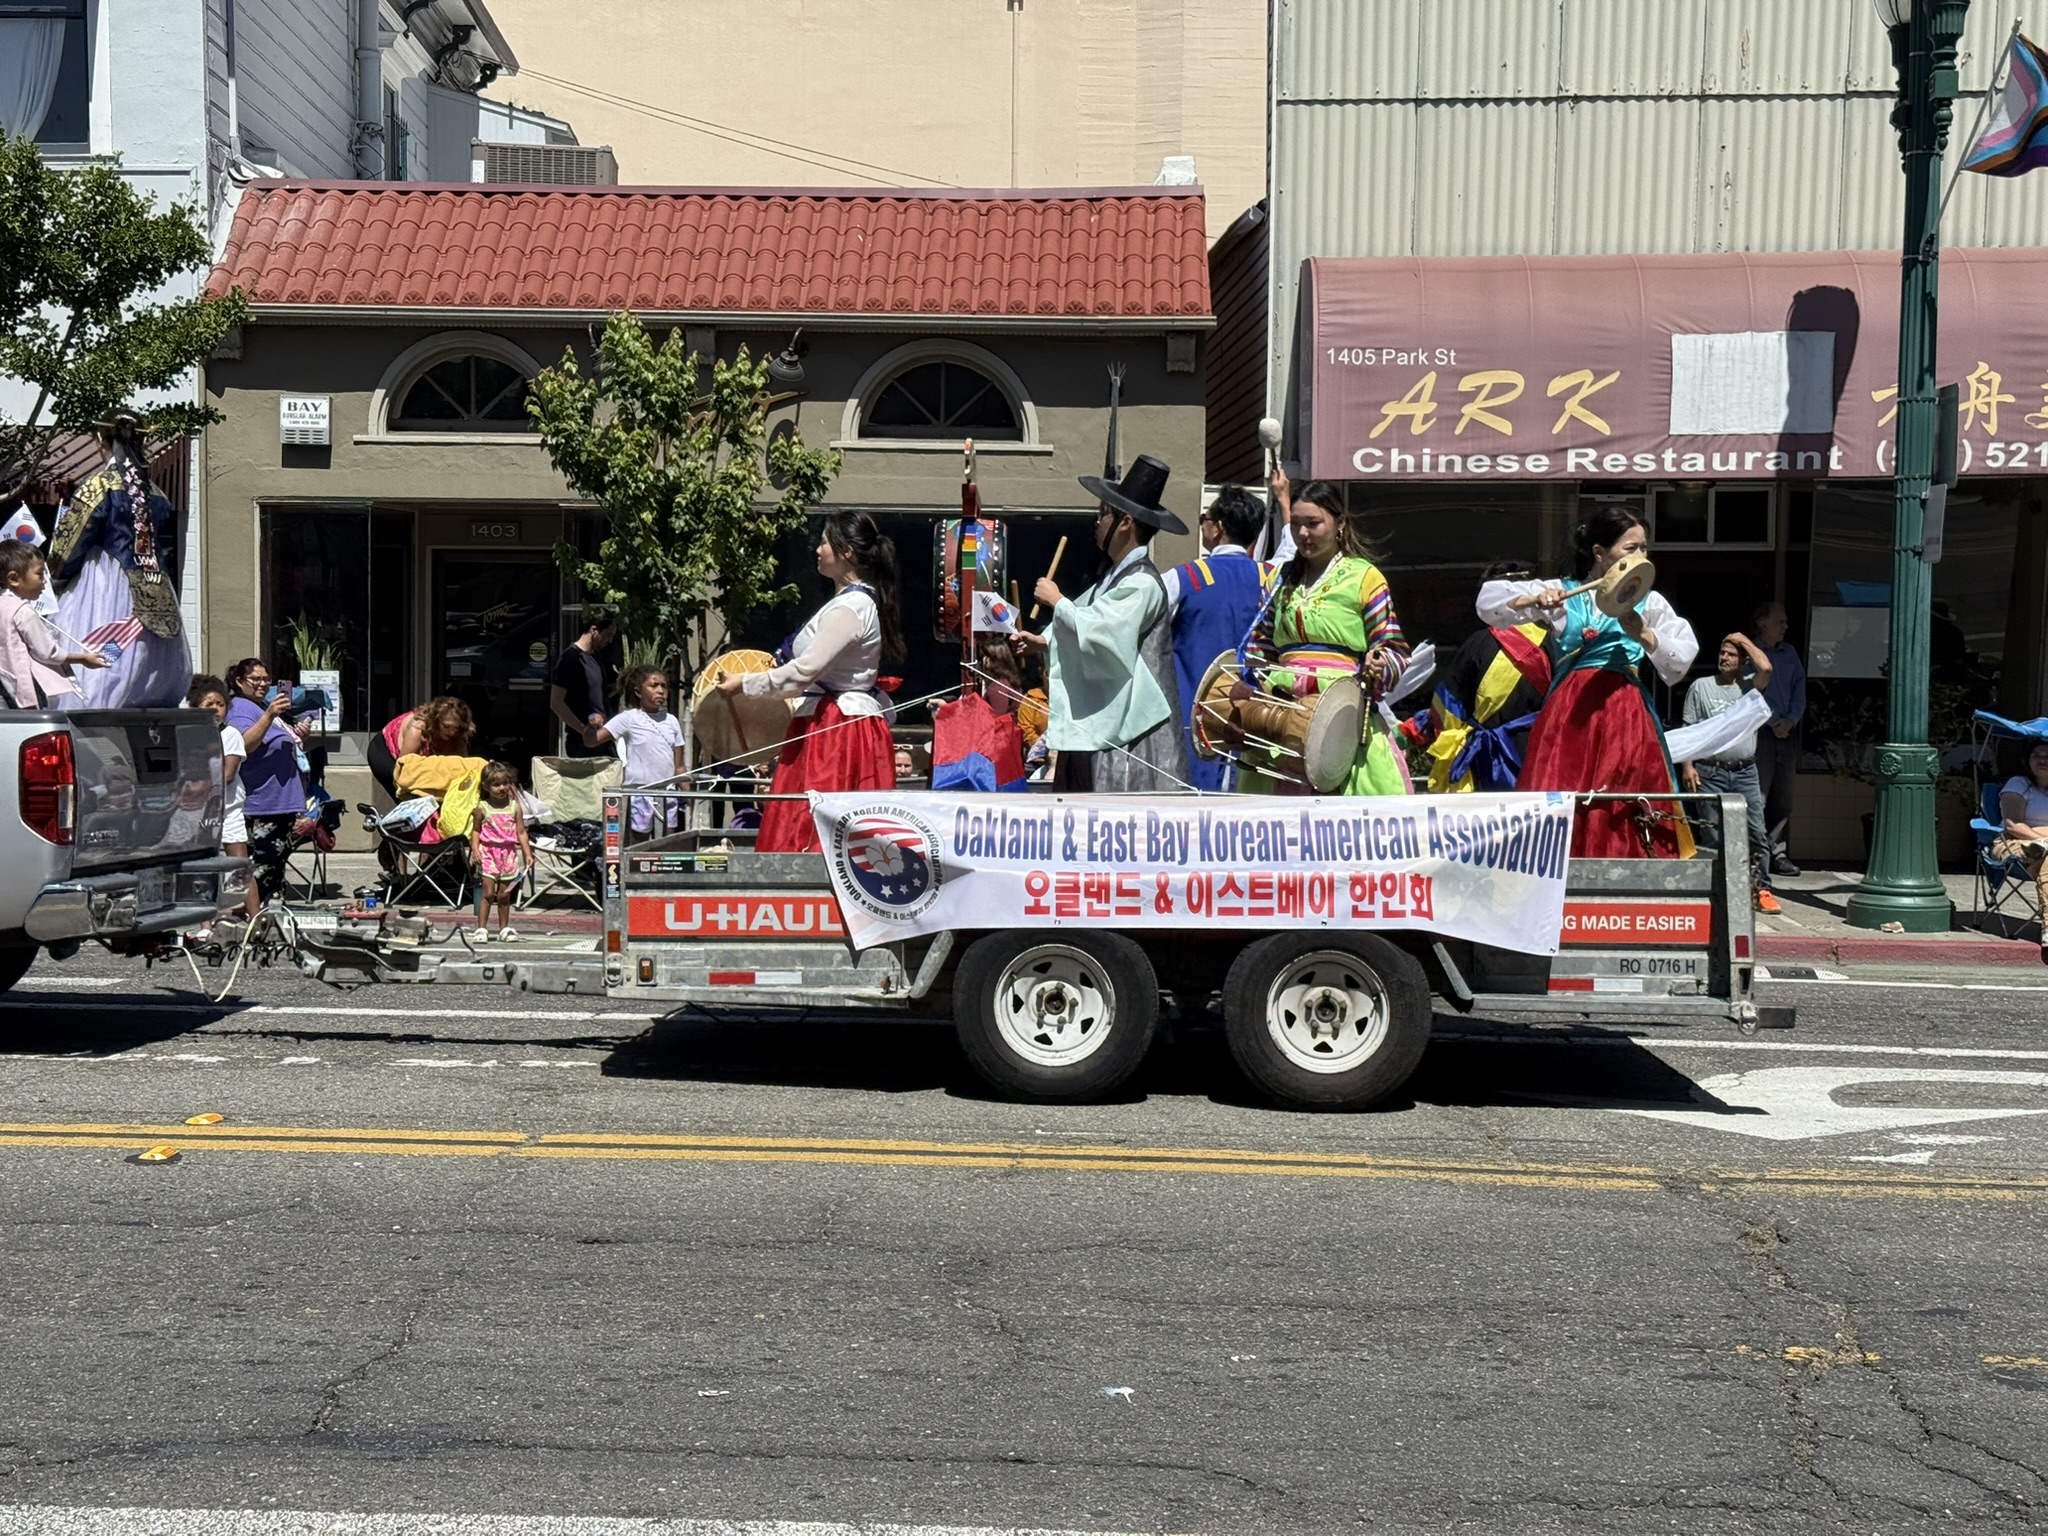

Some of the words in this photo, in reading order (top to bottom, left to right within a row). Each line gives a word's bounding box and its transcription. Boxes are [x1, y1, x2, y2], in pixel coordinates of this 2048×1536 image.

[1327, 348, 1376, 365] 1405
[1382, 348, 1429, 365] Park
[1434, 348, 1457, 365] St
[288, 401, 322, 412] BAY
[1368, 369, 1621, 439] ARK
[1352, 447, 1550, 473] Chinese
[1566, 445, 1844, 473] Restaurant
[471, 525, 516, 537] 1403
[953, 806, 1054, 861] Oakland
[1062, 807, 1078, 861] &
[1087, 808, 1138, 862] East
[1146, 809, 1190, 866] Bay
[1199, 808, 1420, 862] Korean-American
[1427, 803, 1569, 879] Association
[835, 861, 862, 901] OAKLAND
[853, 806, 890, 816] KOREAN
[891, 807, 931, 836] AMERICAN
[928, 833, 943, 884] ASSOCIATION
[1024, 870, 1141, 917] 오클랜드
[1154, 871, 1174, 914] &
[1186, 870, 1334, 918] 이스트베이
[1348, 870, 1434, 921] 한인회
[1581, 916, 1631, 930] MADE
[1635, 916, 1696, 930] EASIER
[1620, 958, 1641, 973] RO
[1648, 959, 1681, 973] 0716
[1686, 959, 1696, 973] H
